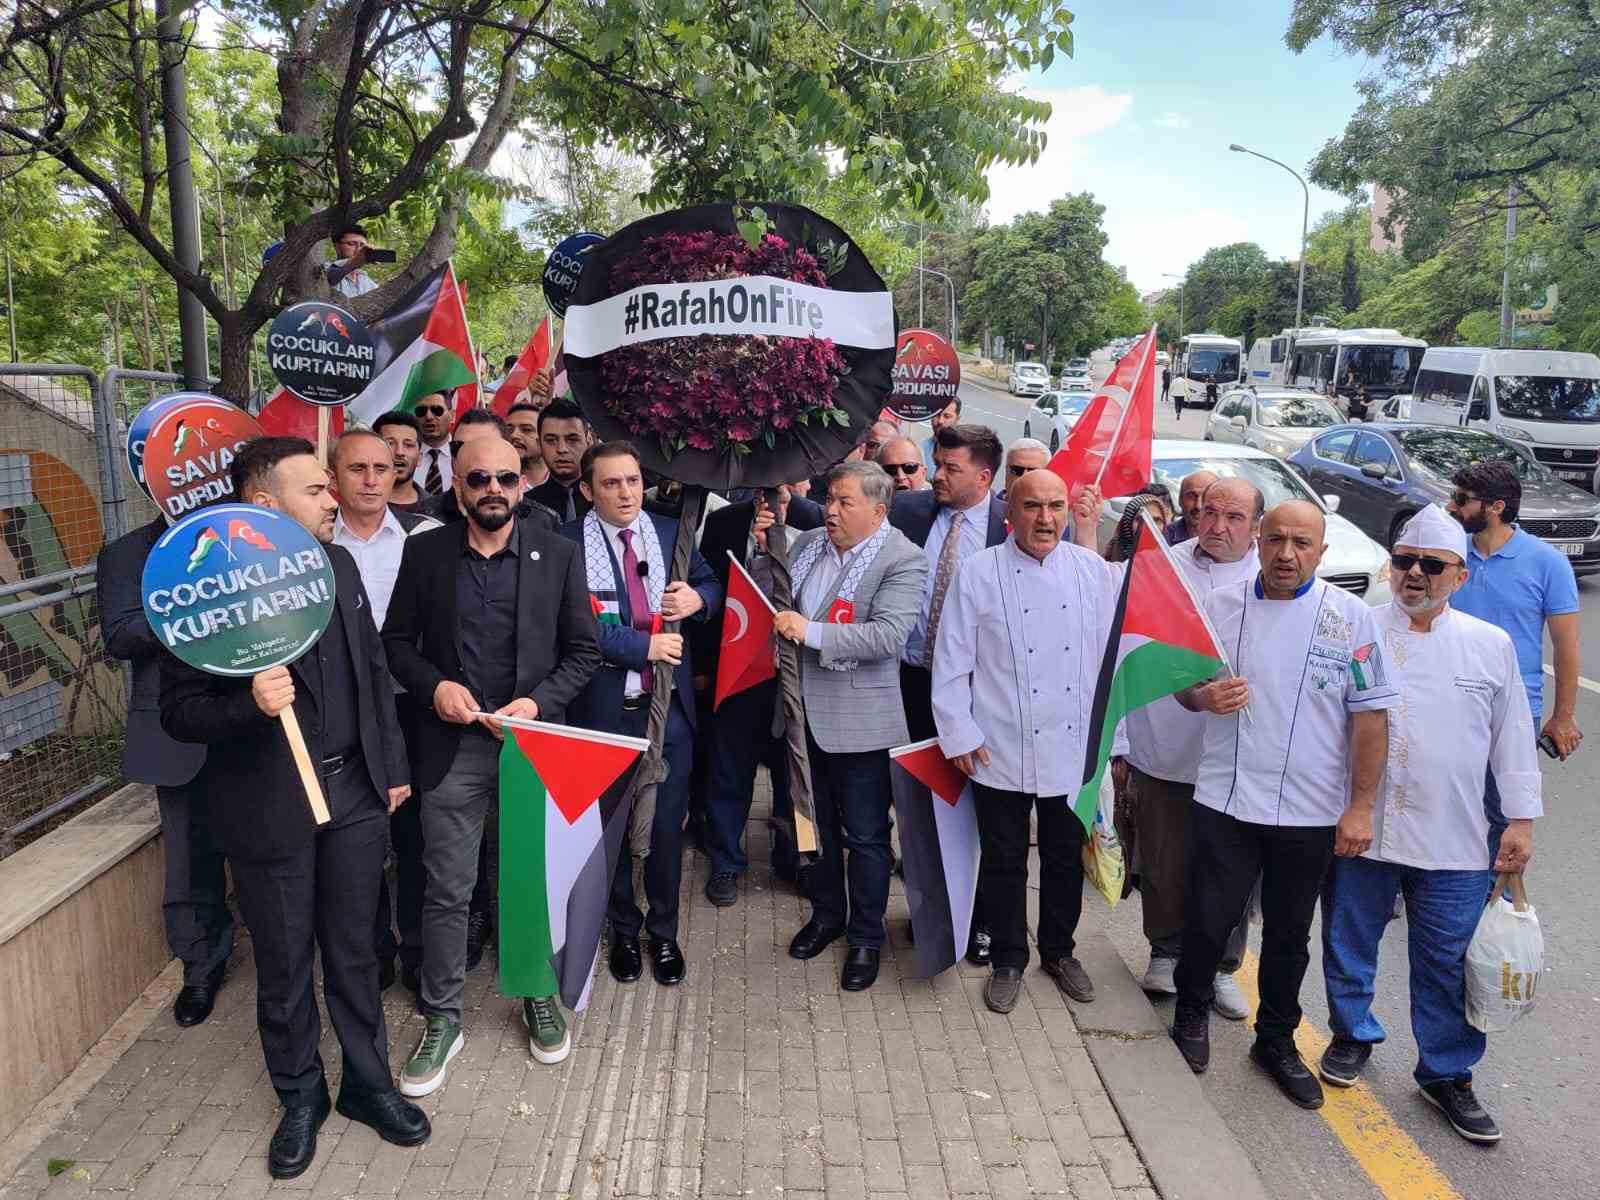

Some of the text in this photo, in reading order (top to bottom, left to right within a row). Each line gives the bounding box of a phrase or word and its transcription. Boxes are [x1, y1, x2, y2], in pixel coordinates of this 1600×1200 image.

[624, 284, 824, 335] #RafahOnFire
[272, 353, 370, 379] KURTARIN!
[166, 475, 235, 516] DURDU
[148, 547, 325, 617] ÇOCUKLARI
[162, 578, 330, 647] KURTARIN!
